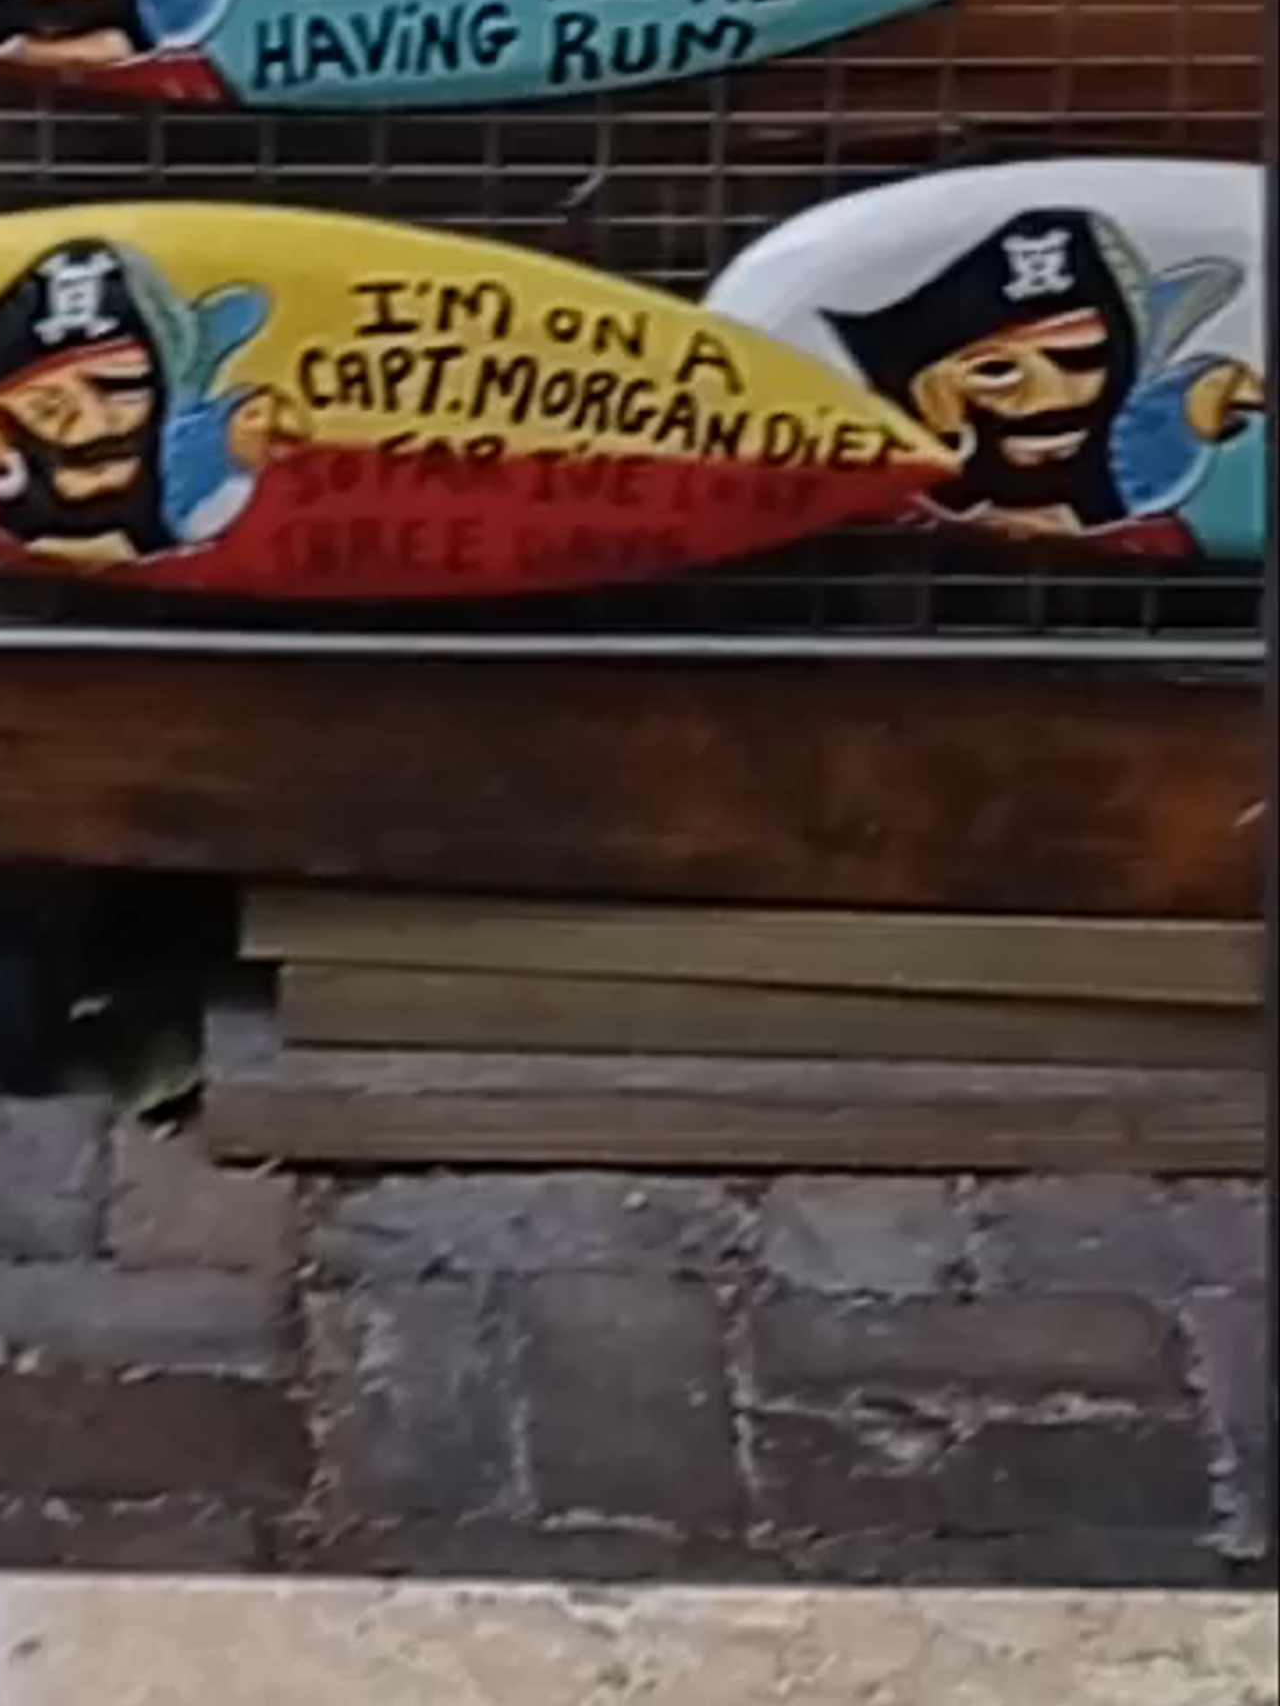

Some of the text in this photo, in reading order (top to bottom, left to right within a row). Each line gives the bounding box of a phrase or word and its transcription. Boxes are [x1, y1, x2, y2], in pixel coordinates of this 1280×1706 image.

[546, 11, 756, 85] RUM
[350, 280, 744, 397] I'M ON A
